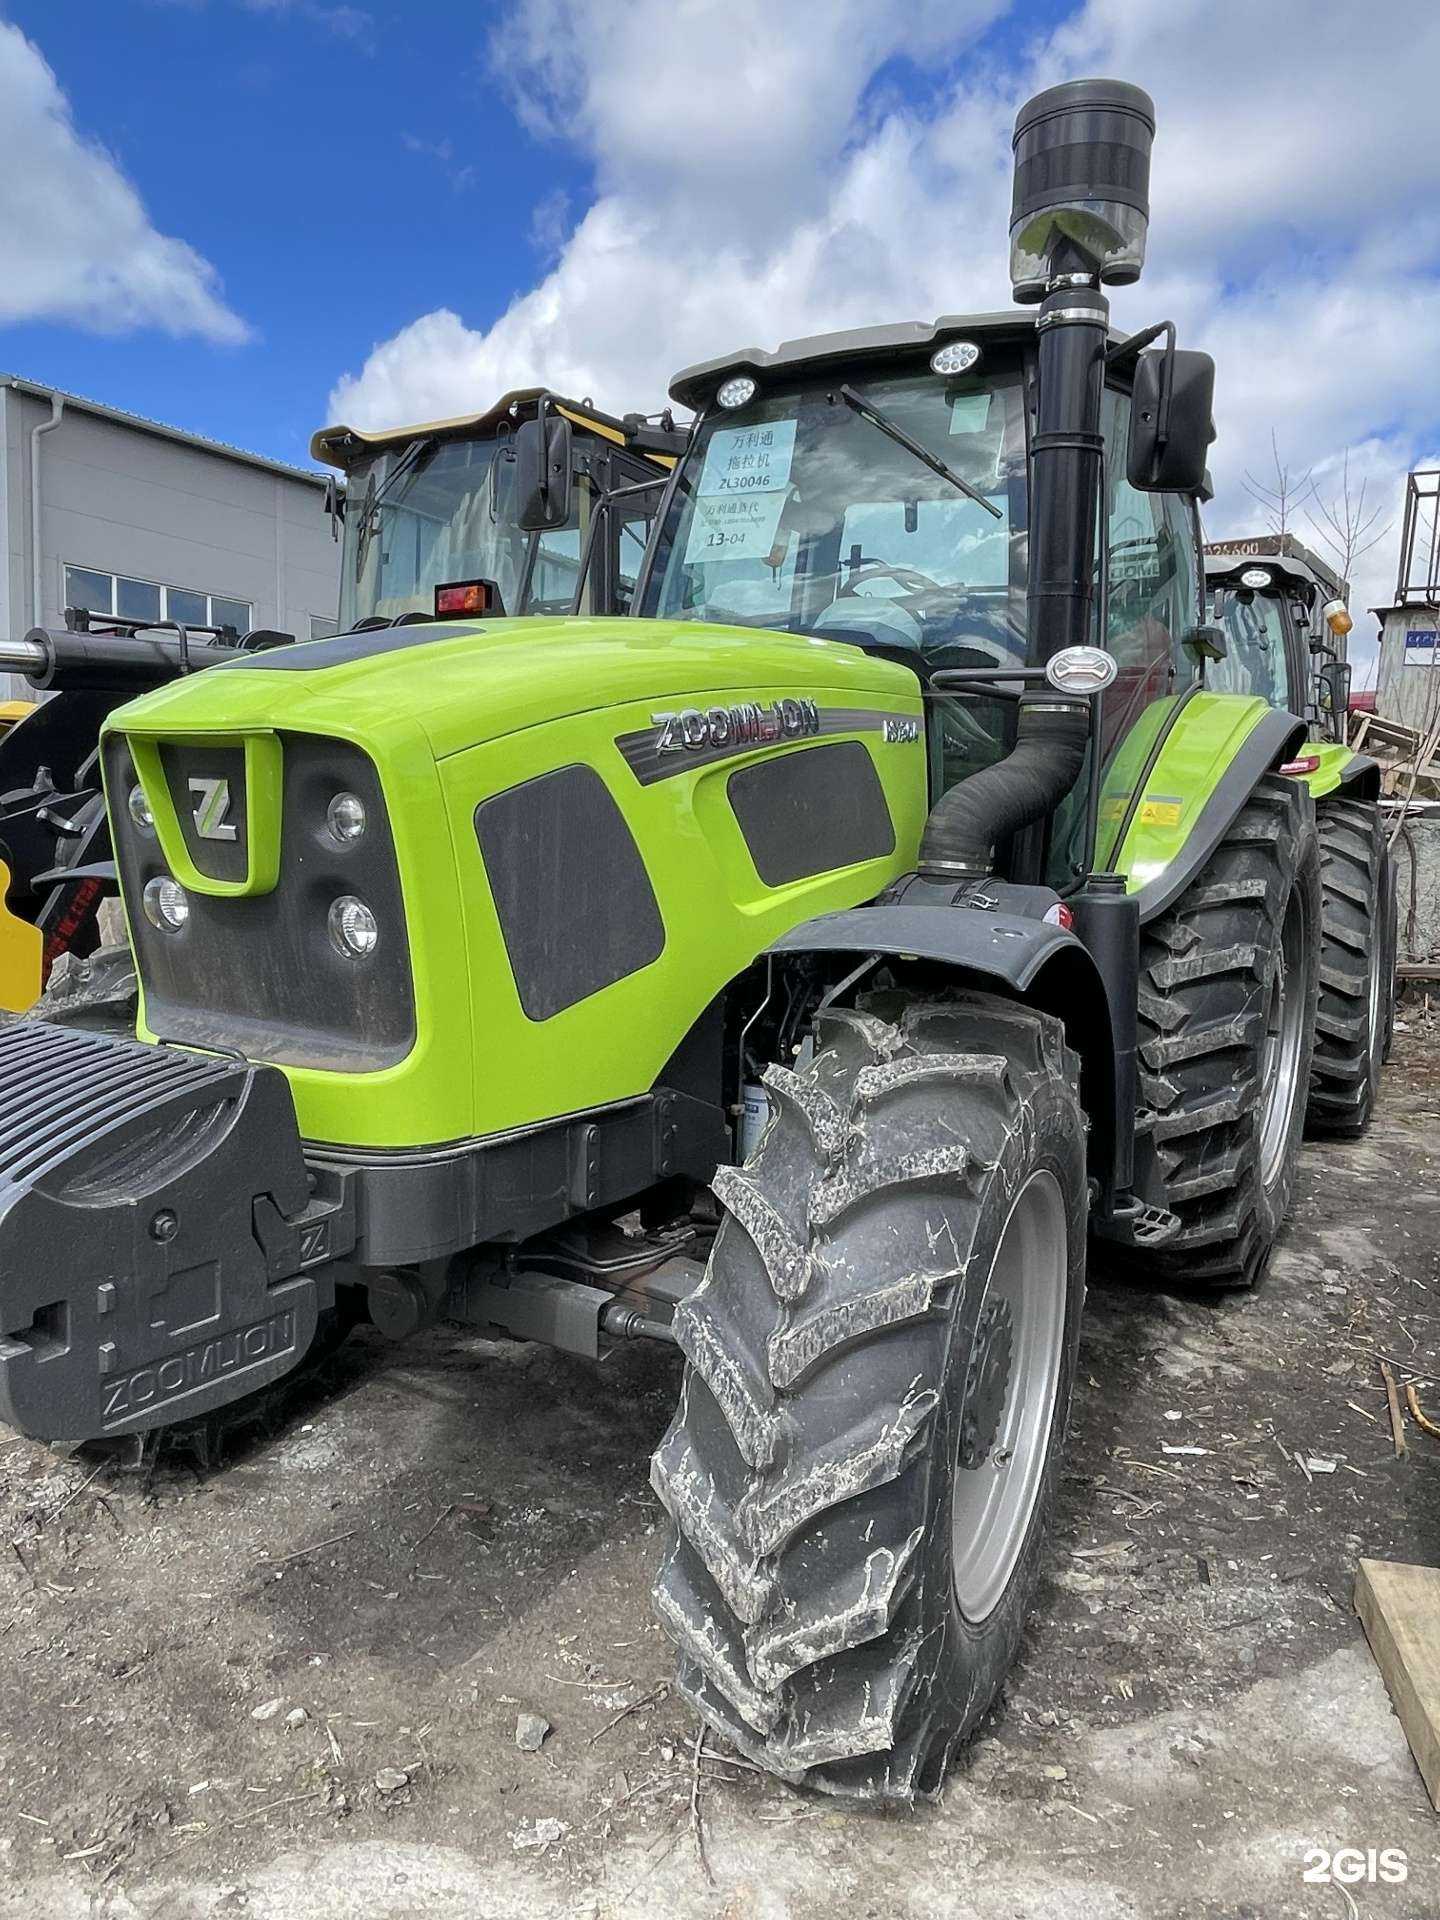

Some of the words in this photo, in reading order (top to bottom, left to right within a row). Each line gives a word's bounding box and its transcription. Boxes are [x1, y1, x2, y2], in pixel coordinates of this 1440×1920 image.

[731, 430, 774, 449] 万利通
[728, 453, 770, 471] 拖拉机
[719, 475, 770, 490] ZL30046
[706, 532, 747, 547] 13-04
[651, 697, 819, 756] ZOOMLION
[103, 1313, 291, 1415] ZOOMLION
